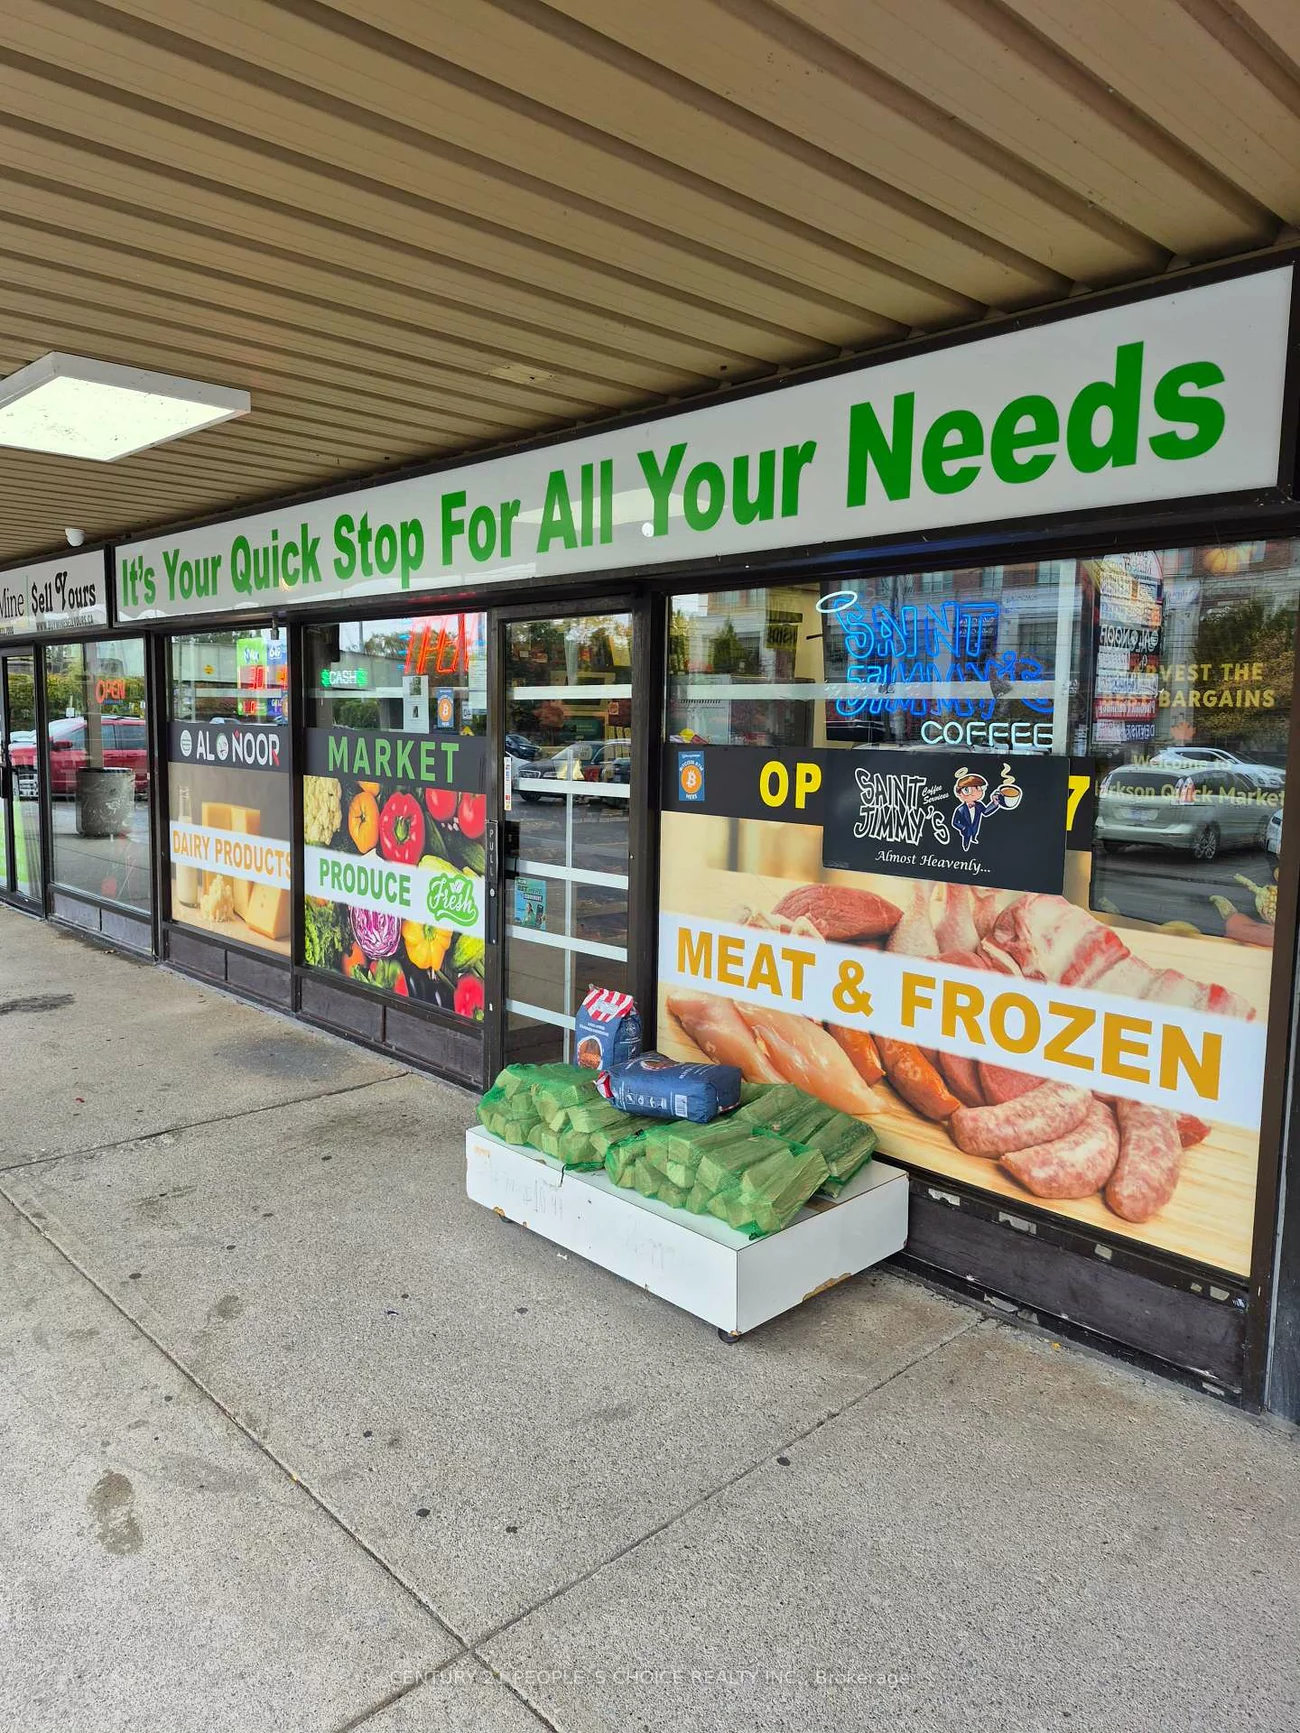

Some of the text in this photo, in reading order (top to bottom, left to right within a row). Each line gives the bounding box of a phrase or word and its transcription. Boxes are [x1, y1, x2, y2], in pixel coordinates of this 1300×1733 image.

[122, 340, 1227, 608] It's Your Quick Stop For All Your Needs
[55, 570, 97, 612] Yours
[834, 598, 1000, 660] SAINT
[95, 677, 126, 704] OPEN
[1222, 662, 1264, 682] THE
[1157, 689, 1275, 709] BARGAINS
[196, 729, 216, 761] AL
[232, 729, 280, 767] NOOR
[921, 720, 1054, 748] COFFEE
[328, 735, 460, 784] MARKET
[1133, 753, 1208, 770] Welcome
[760, 760, 822, 809] OP
[854, 767, 927, 810] SAINT
[921, 784, 943, 797] Coffee
[923, 792, 950, 805] Services
[853, 805, 950, 846] JIMMY'S
[172, 830, 210, 861] DAIRY
[875, 850, 917, 865] Almost
[319, 858, 411, 907] PRODUCE
[429, 877, 477, 913] Fresh
[676, 927, 1223, 1101] MEAT & FROZEN
